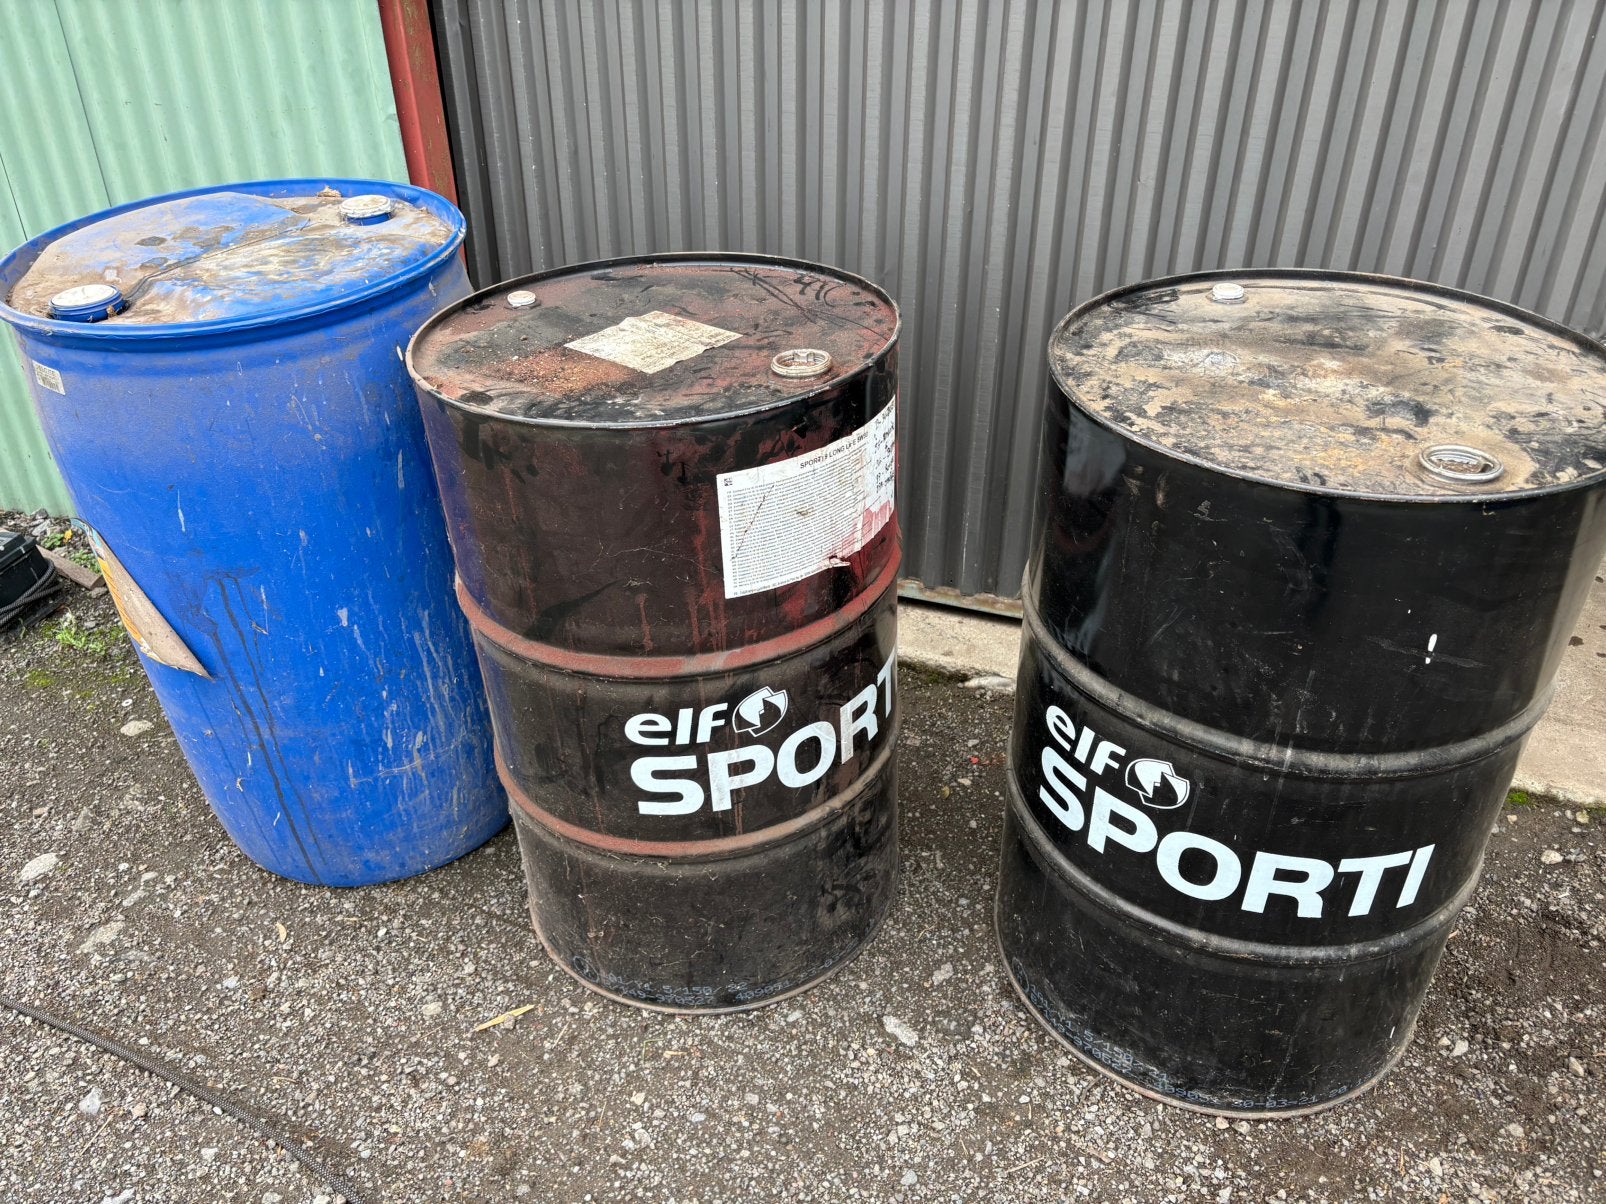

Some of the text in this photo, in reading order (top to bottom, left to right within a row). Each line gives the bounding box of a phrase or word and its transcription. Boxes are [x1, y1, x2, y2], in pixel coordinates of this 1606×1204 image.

[829, 445, 845, 458] LONG
[624, 702, 728, 746] elf
[1045, 704, 1127, 776] elf
[1039, 746, 1436, 919] SPORTI
